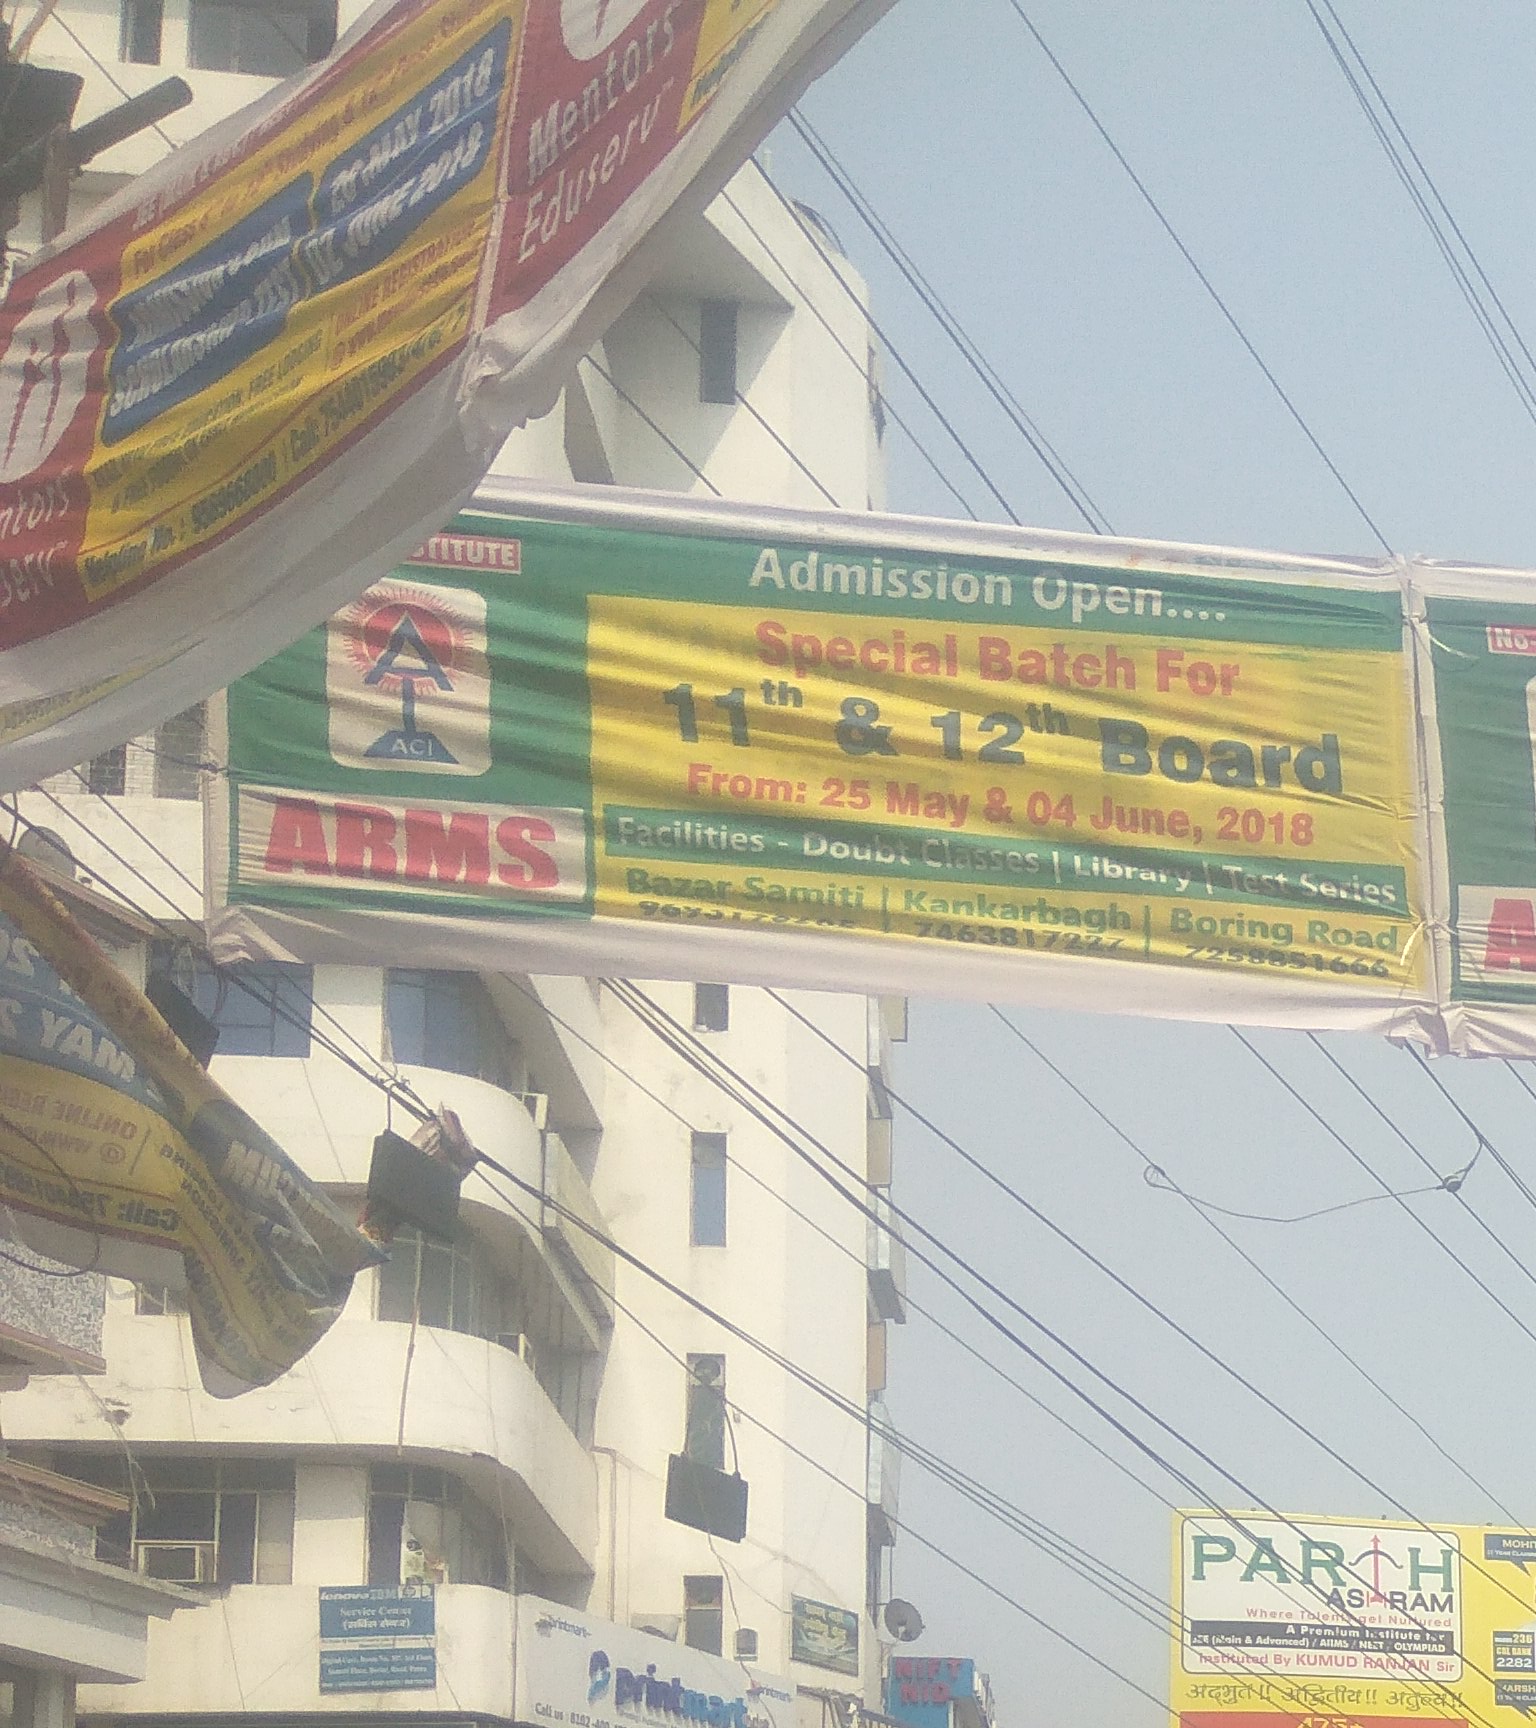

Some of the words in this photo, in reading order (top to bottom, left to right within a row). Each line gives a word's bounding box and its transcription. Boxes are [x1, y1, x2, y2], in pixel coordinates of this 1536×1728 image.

[527, 5, 675, 184] Mentors
[749, 547, 1012, 607] Admission
[754, 619, 957, 679] Special
[979, 637, 1136, 690] Batch
[1156, 650, 1240, 696] For
[835, 696, 897, 757] &
[1101, 717, 1343, 795] Board
[265, 796, 558, 889] ARMS
[1274, 1655, 1291, 1666] By
[1296, 1655, 1357, 1667] KUMUD
[1364, 1657, 1429, 1671] RANJAN
[1437, 1661, 1455, 1672] Sir
[1496, 1658, 1532, 1667] 2282
